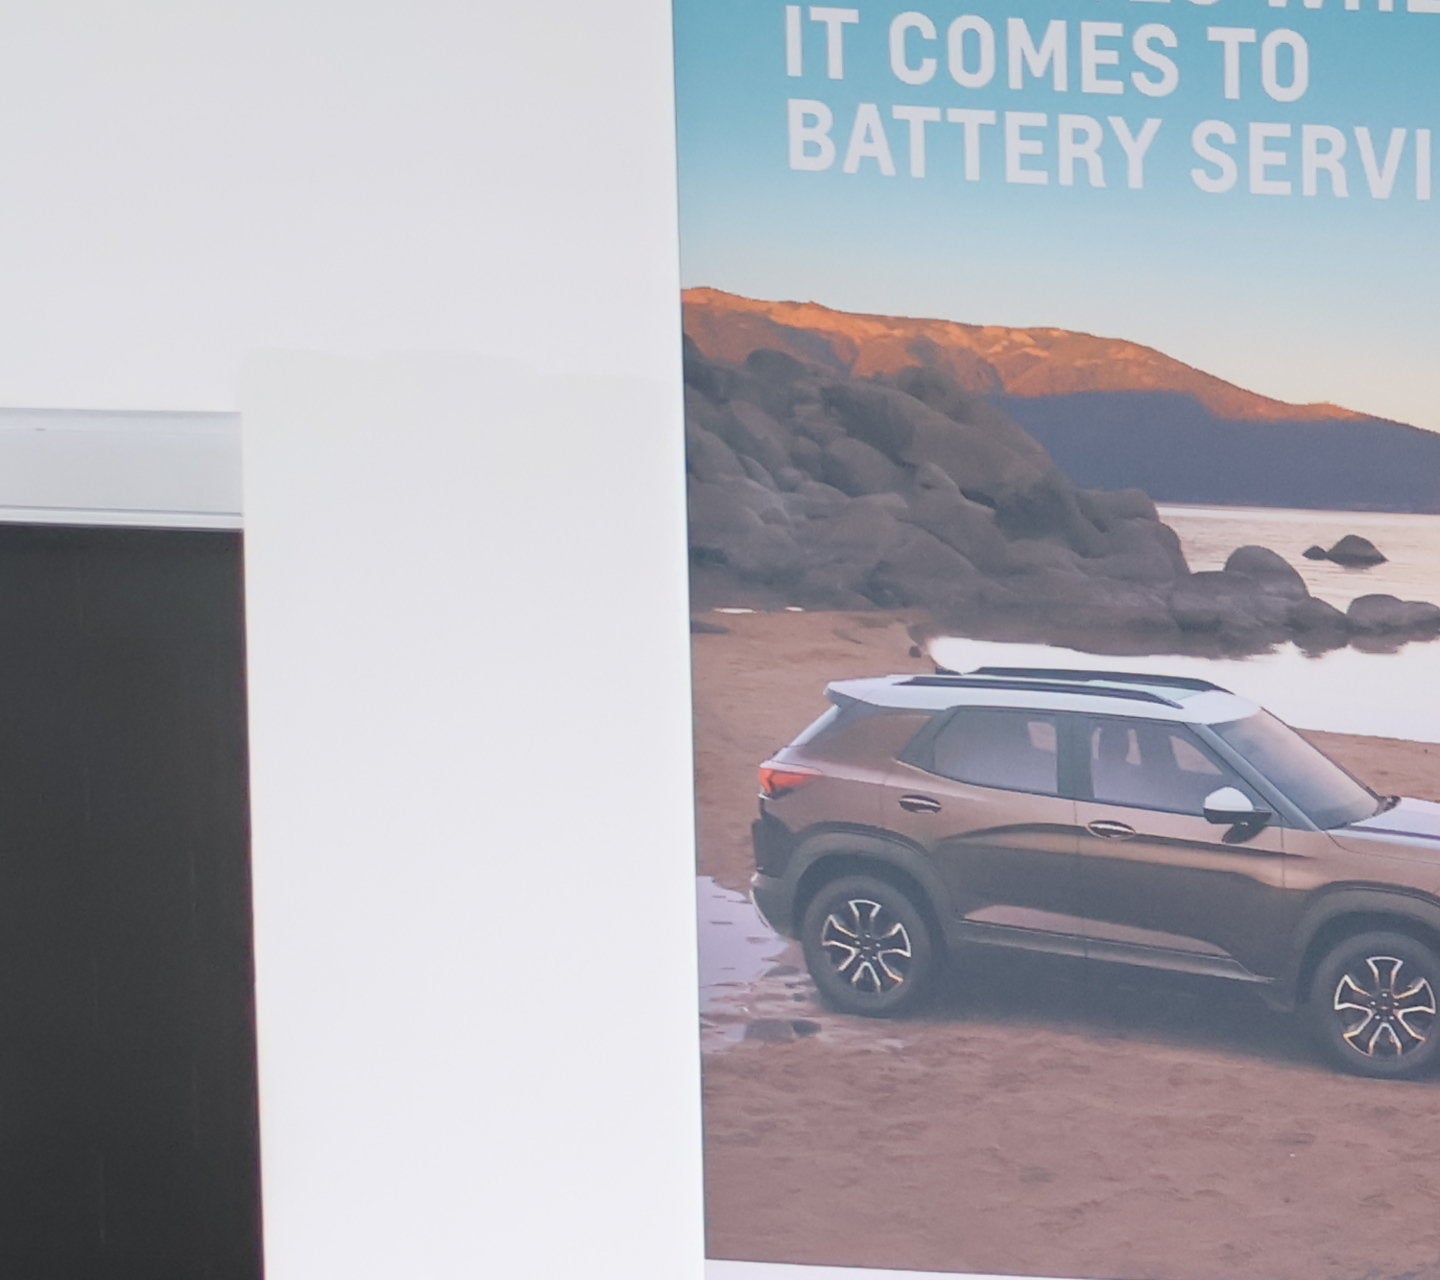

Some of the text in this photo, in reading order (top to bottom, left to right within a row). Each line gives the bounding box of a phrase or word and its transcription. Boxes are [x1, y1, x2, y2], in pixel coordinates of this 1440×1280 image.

[785, 5, 1309, 103] IT COMES TO
[787, 98, 1163, 189] BATTERY
